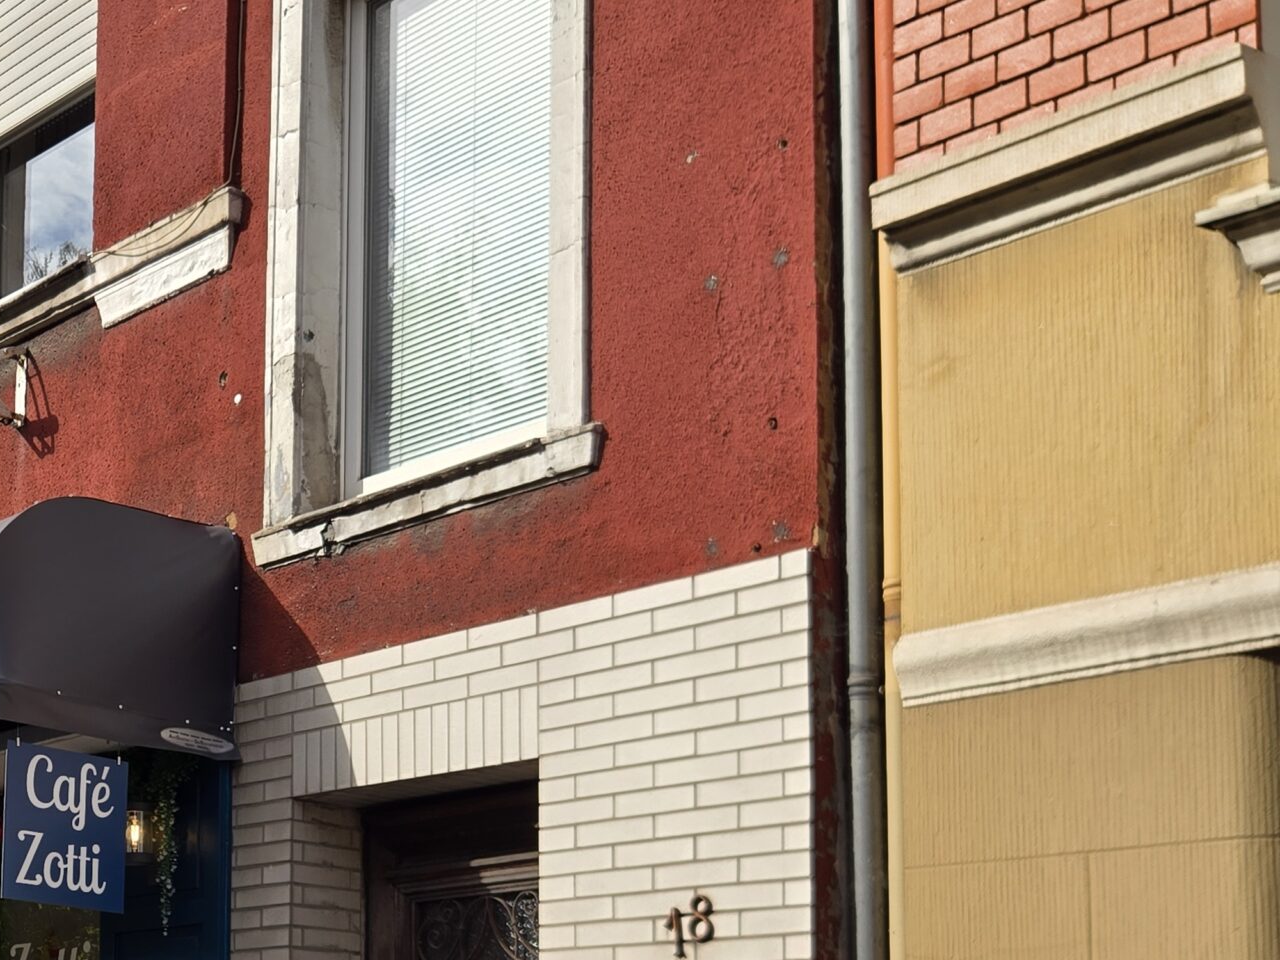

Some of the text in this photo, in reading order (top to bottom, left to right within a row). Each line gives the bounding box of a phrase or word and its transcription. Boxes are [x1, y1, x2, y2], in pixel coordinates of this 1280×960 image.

[26, 754, 115, 831] Café
[15, 830, 107, 895] Zotti
[663, 894, 715, 960] 18
